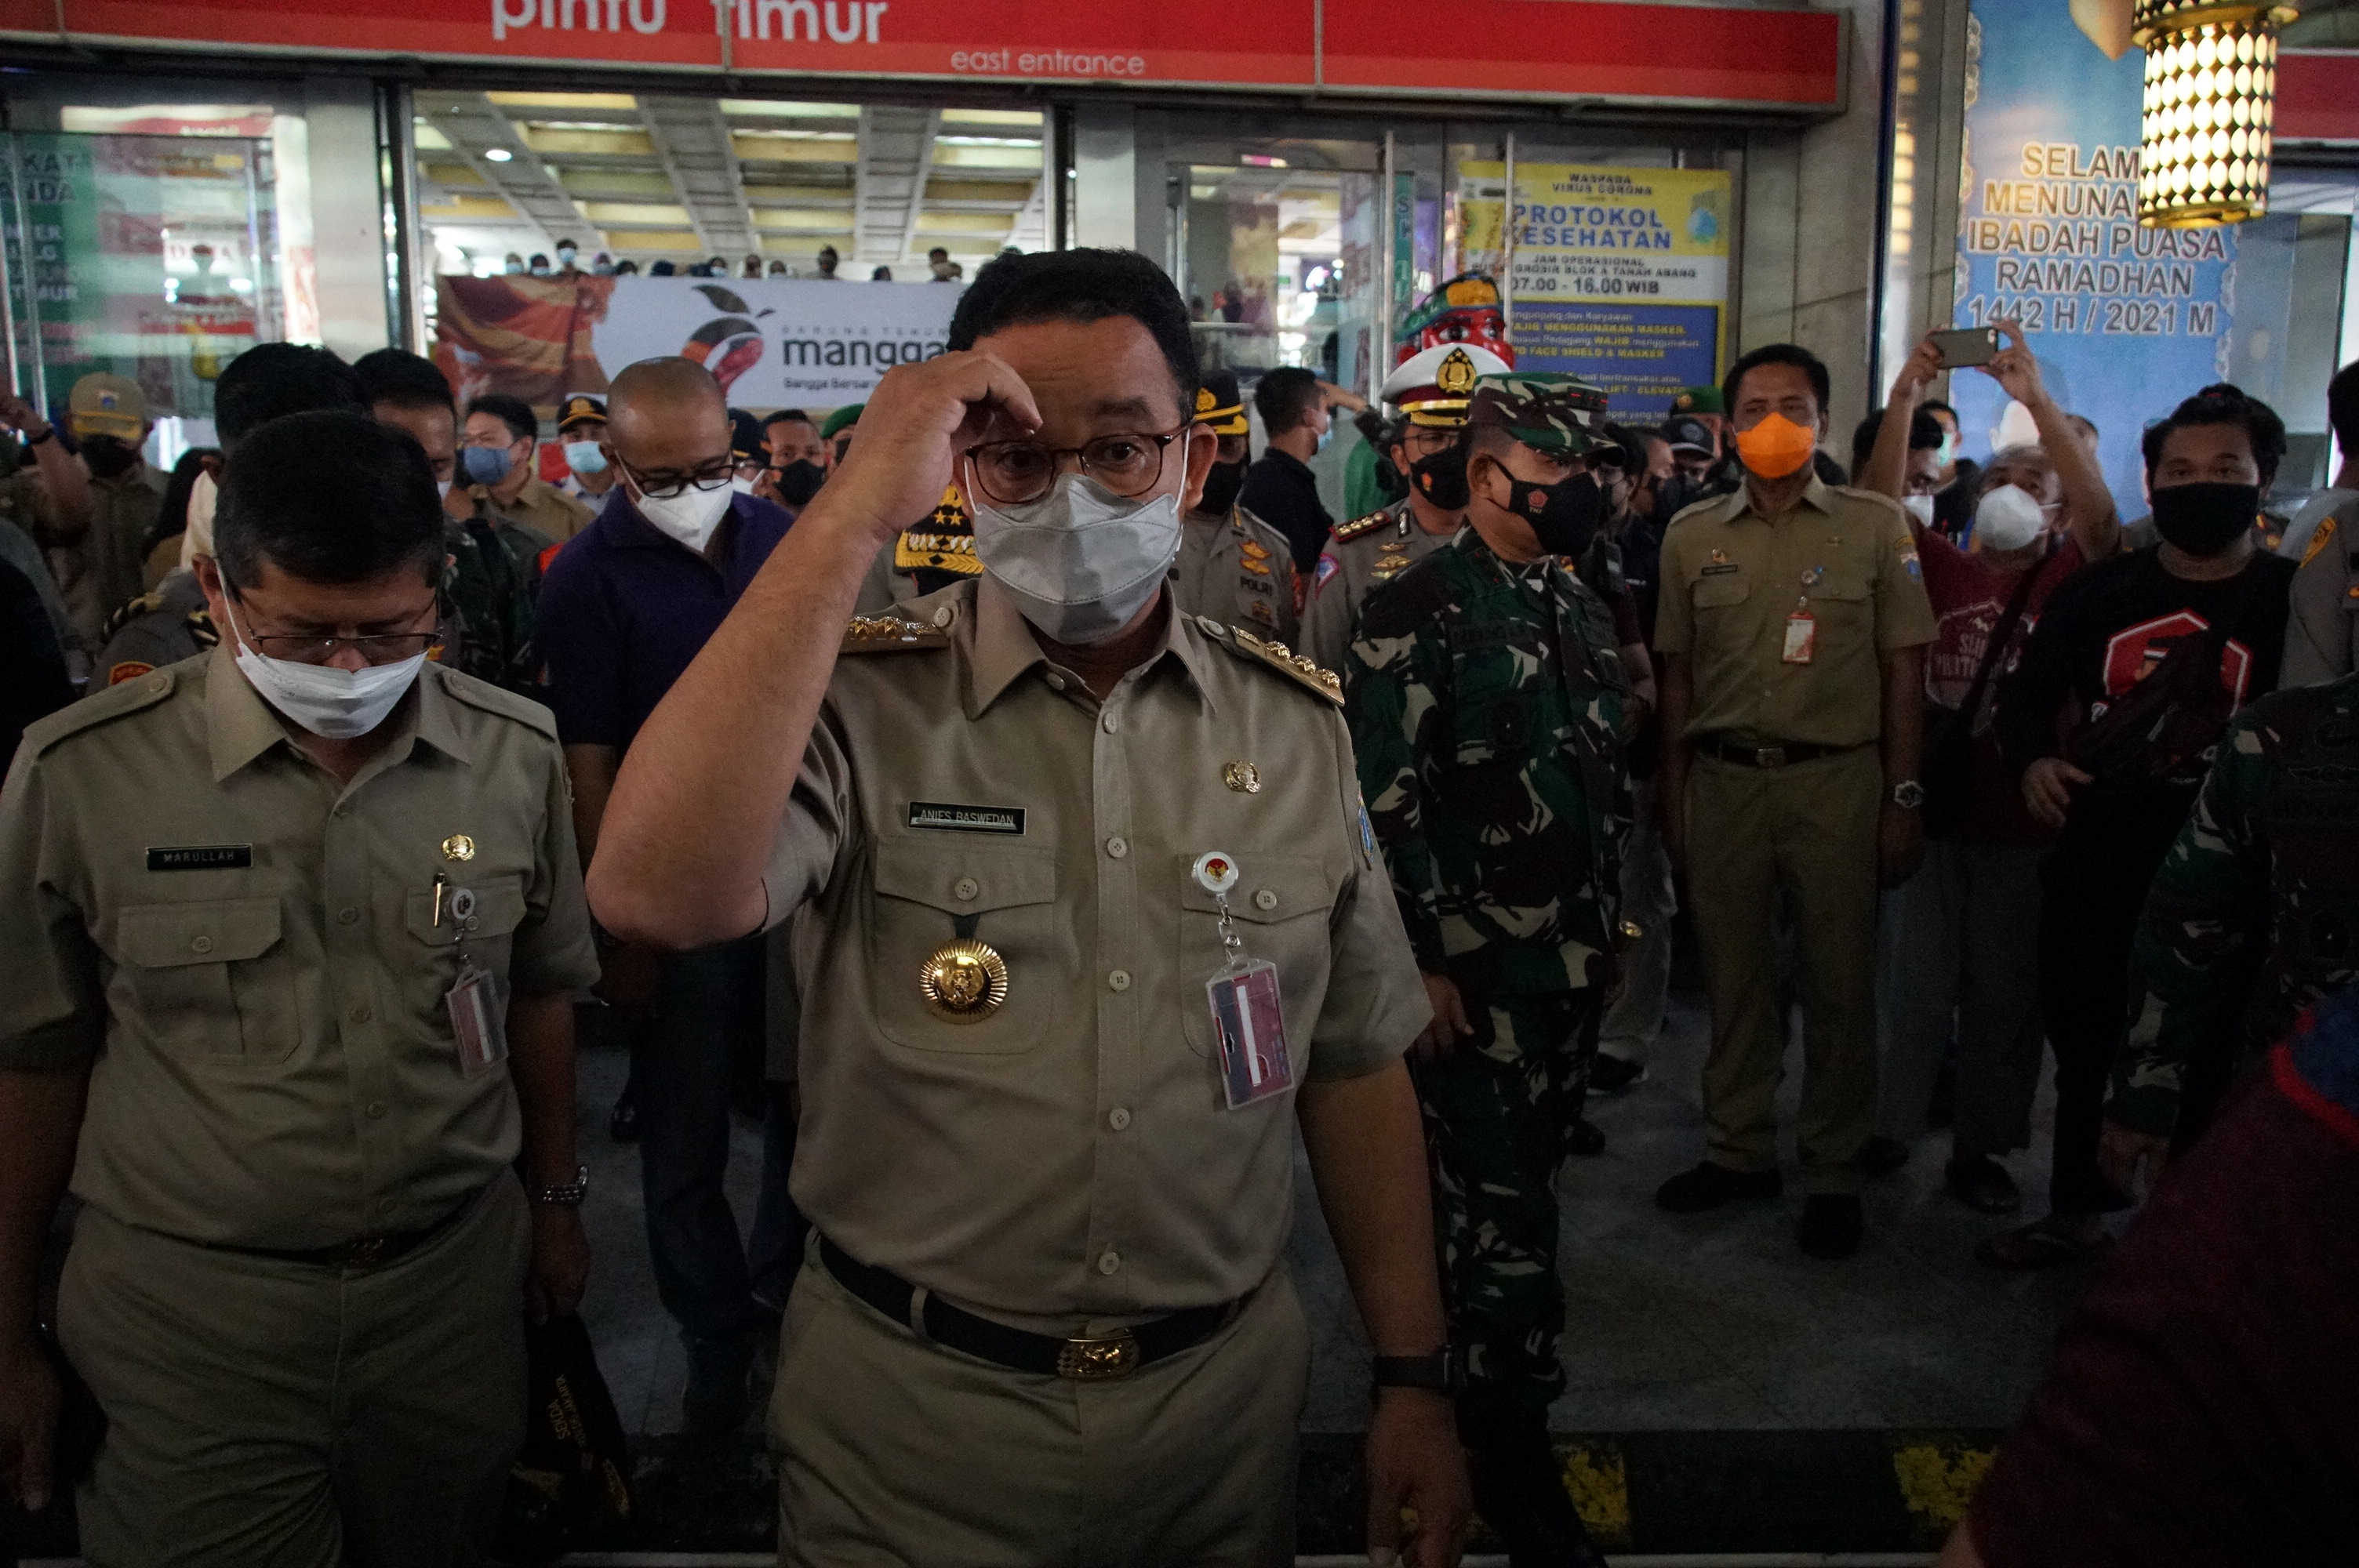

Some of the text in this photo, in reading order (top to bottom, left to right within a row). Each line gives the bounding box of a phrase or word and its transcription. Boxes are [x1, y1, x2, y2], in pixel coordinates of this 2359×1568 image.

[713, 0, 889, 44] timur
[950, 49, 1146, 76] east entrance
[1552, 183, 1652, 195] VIRUS CORONA
[1983, 182, 2140, 216] MENUNA
[1968, 220, 2226, 260] IBADAH PUASA
[1534, 254, 1645, 267] JAM OPERASIONAL
[1565, 266, 1595, 274] BLOK
[1613, 267, 1652, 276] TANAH
[1656, 268, 1697, 278] ABANG
[1996, 260, 2193, 296] RAMADHAN
[1573, 278, 1622, 293] 16.00
[1626, 280, 1659, 294] WIB
[1968, 298, 2215, 335] 1442 H / 2021 M
[1239, 576, 1274, 597] POLRI
[920, 809, 1014, 826] ANIES BASWEDAN
[163, 851, 235, 863] MARULLAH
